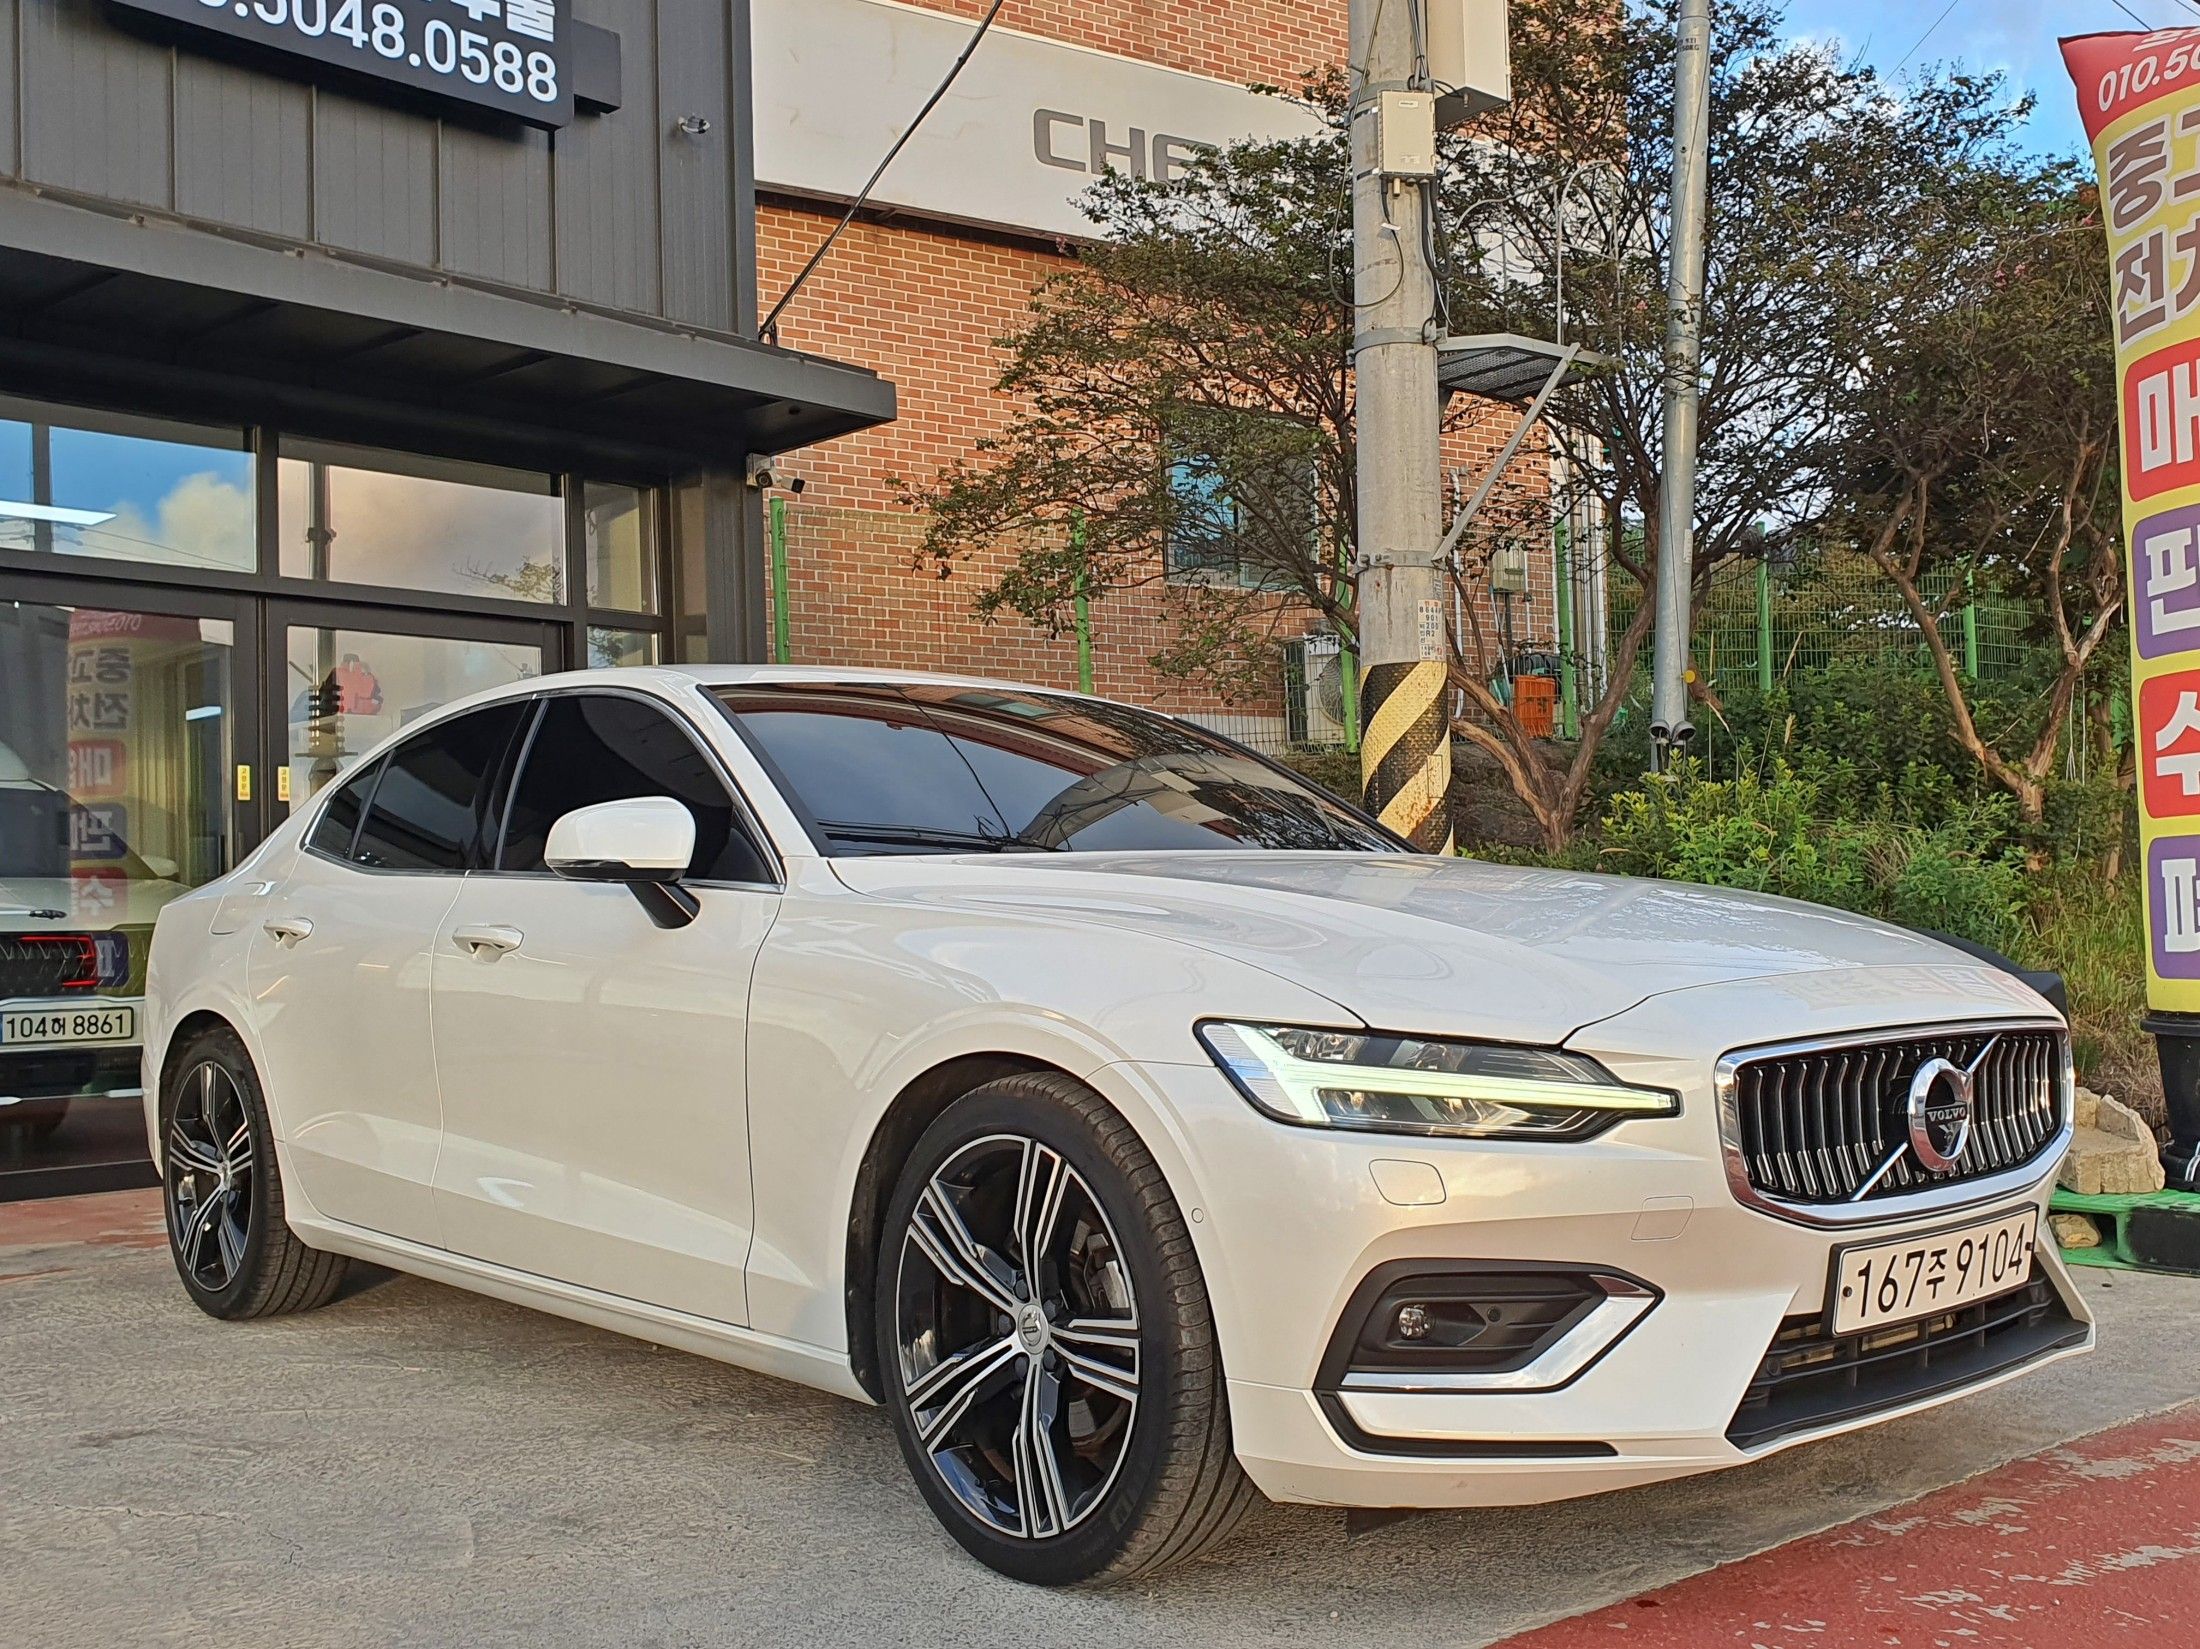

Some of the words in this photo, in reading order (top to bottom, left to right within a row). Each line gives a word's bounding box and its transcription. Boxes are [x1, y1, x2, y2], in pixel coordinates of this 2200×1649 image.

[6, 1016, 66, 1039] 104허
[72, 1013, 123, 1036] 8861
[1927, 1107, 1966, 1122] VOLVO
[1857, 1248, 1948, 1318] 167주
[1956, 1222, 2025, 1296] 9104
